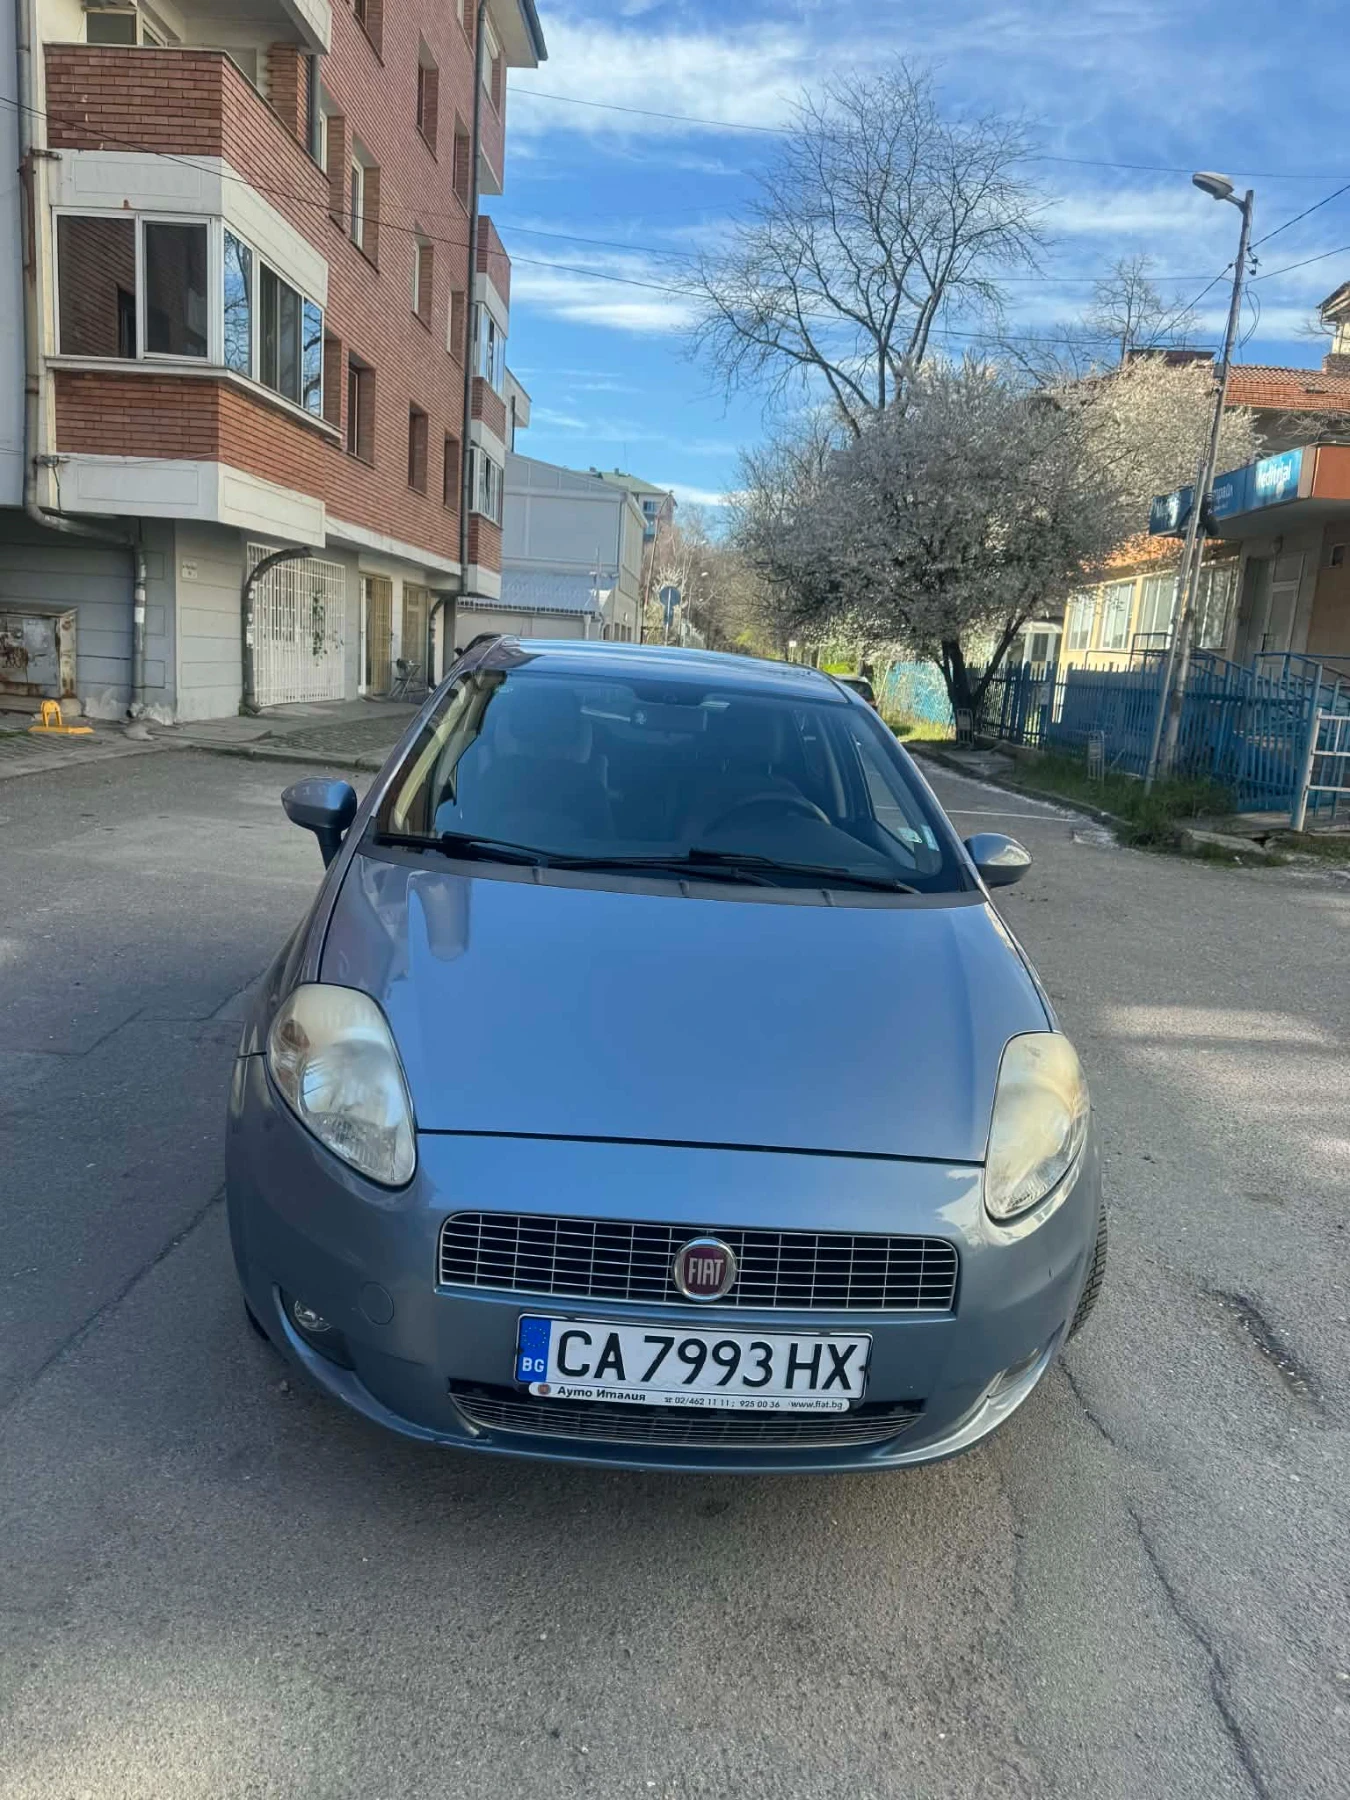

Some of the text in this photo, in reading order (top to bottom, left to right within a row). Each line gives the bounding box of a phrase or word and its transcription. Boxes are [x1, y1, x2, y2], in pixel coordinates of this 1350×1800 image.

[688, 1257, 724, 1286] FIAT
[521, 1356, 545, 1373] BG
[557, 1329, 858, 1390] CA 7993 HX
[557, 1386, 593, 1398] Ауто
[596, 1388, 646, 1401] Италия
[674, 1396, 705, 1406] 02/462
[739, 1400, 755, 1408] 925
[757, 1400, 768, 1408] 00
[791, 1400, 843, 1411] www.fiat.bg
